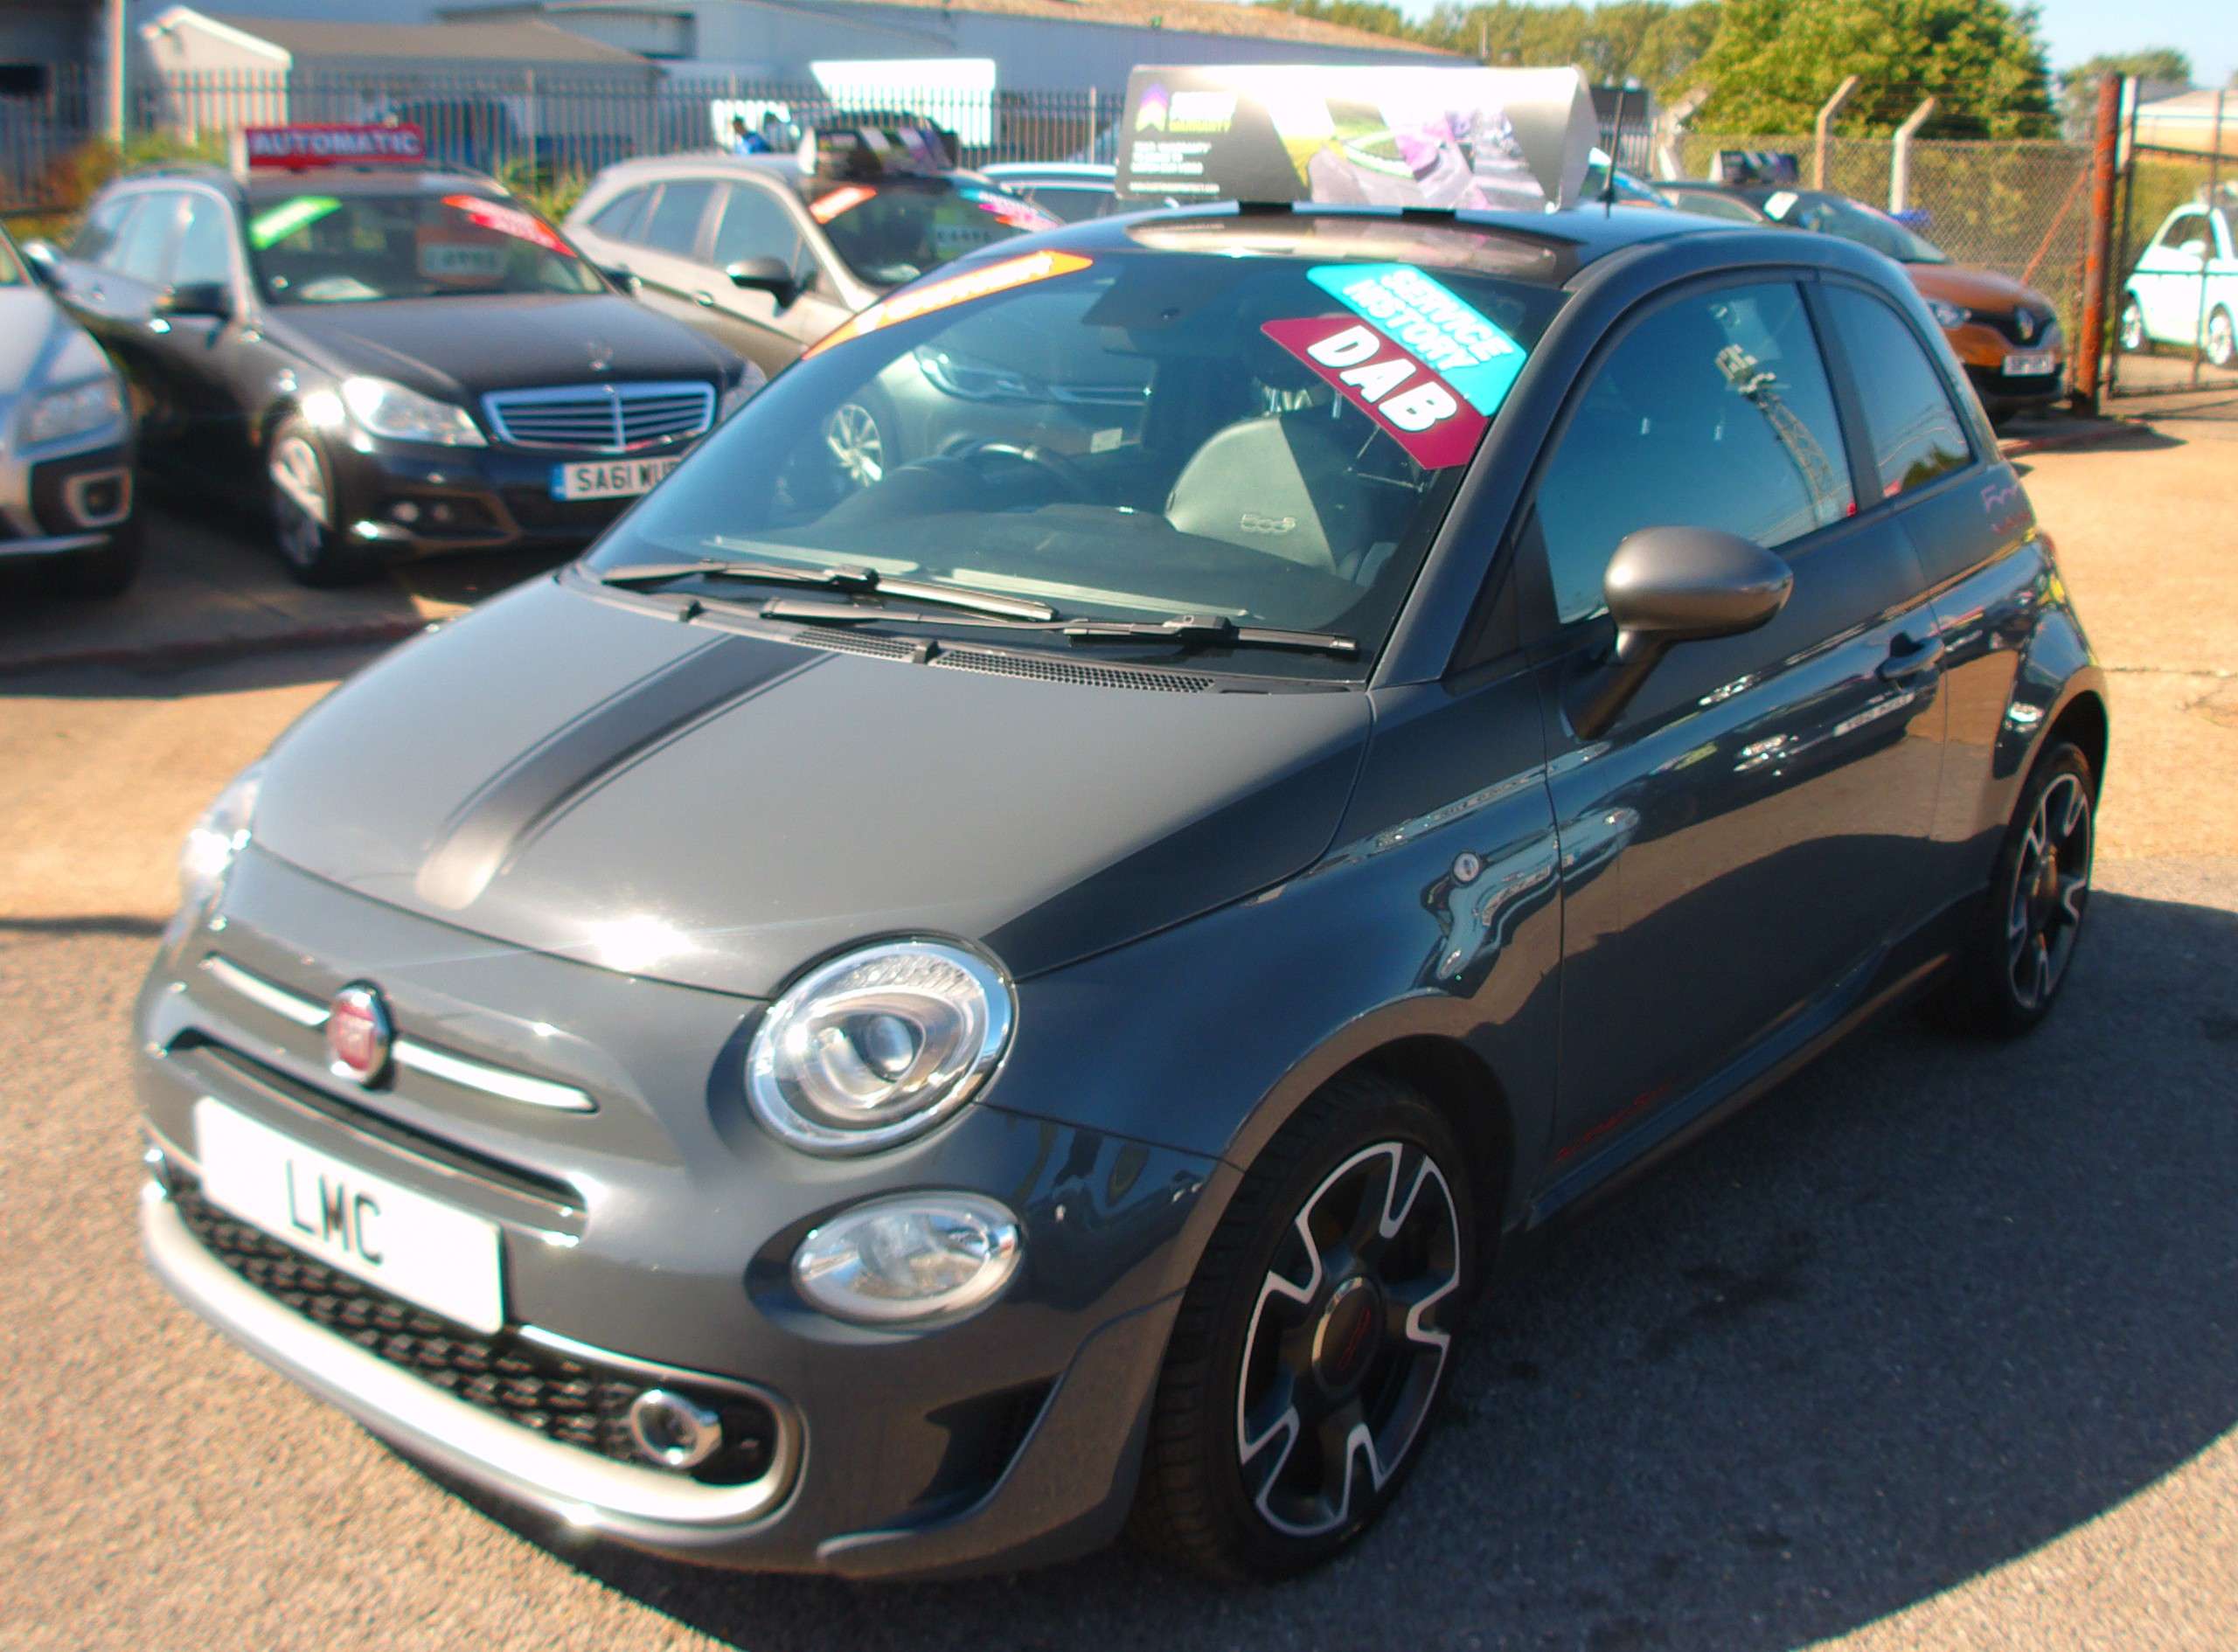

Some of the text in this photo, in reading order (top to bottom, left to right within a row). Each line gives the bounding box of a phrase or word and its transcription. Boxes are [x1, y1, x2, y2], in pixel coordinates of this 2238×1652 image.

[252, 131, 420, 156] AUTOMATIC
[1343, 279, 1480, 371] HISTORY
[1380, 269, 1514, 362] SERVICE
[1307, 325, 1457, 431] DAB
[576, 466, 632, 491] SA61
[286, 1159, 382, 1266] LMC
